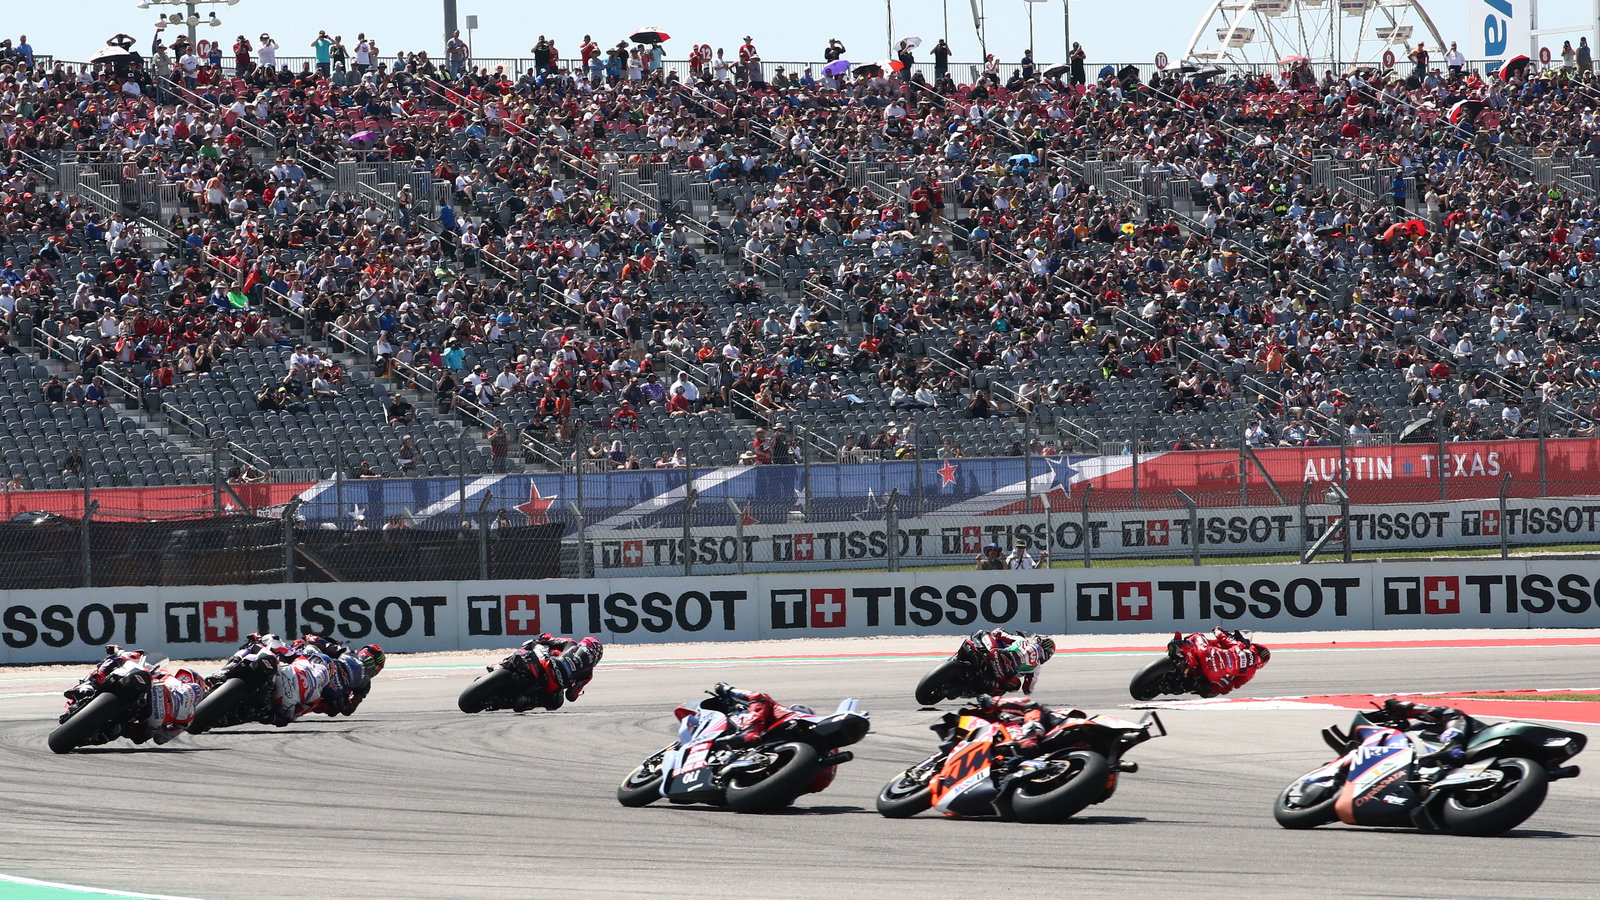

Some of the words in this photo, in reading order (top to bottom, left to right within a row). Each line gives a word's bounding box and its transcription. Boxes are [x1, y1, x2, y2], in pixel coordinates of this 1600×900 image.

[200, 43, 210, 55] 14
[702, 48, 712, 60] 12
[1303, 456, 1393, 482] AUSTIN
[1421, 452, 1501, 478] TEXAS
[1173, 515, 1293, 545] TISSOT
[1349, 511, 1450, 540] TISSOT
[1505, 506, 1600, 534] TISSOT
[646, 535, 760, 566] TISSOT
[984, 521, 1108, 552] TISSOT
[853, 584, 1055, 627] TISSOT
[1158, 578, 1361, 620] TISSOT
[1472, 574, 1600, 614] TISS
[2, 603, 149, 648] SSOT
[244, 596, 448, 639] TISSOT
[546, 591, 748, 634] TISSOT
